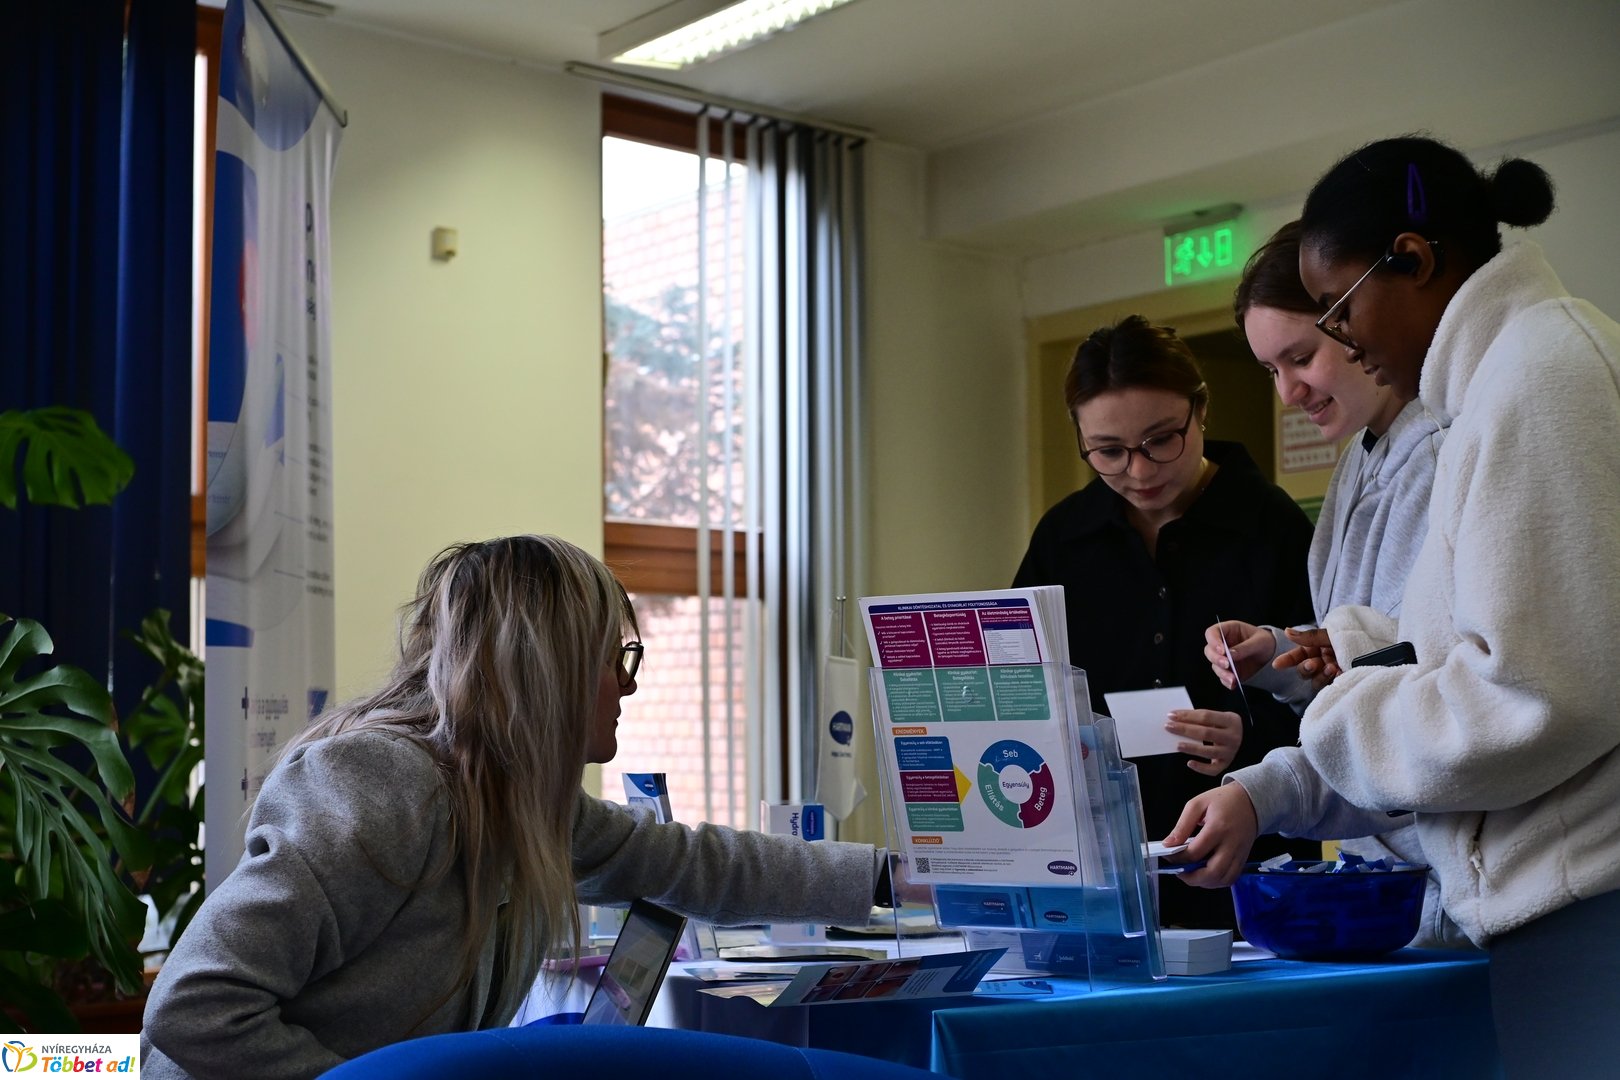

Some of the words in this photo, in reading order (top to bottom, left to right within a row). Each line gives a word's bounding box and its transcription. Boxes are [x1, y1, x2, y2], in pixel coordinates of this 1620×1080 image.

[1002, 750, 1018, 758] Seb
[985, 784, 1004, 811] Ellátás
[1034, 786, 1048, 811] Beteg
[790, 812, 799, 836] Hydro
